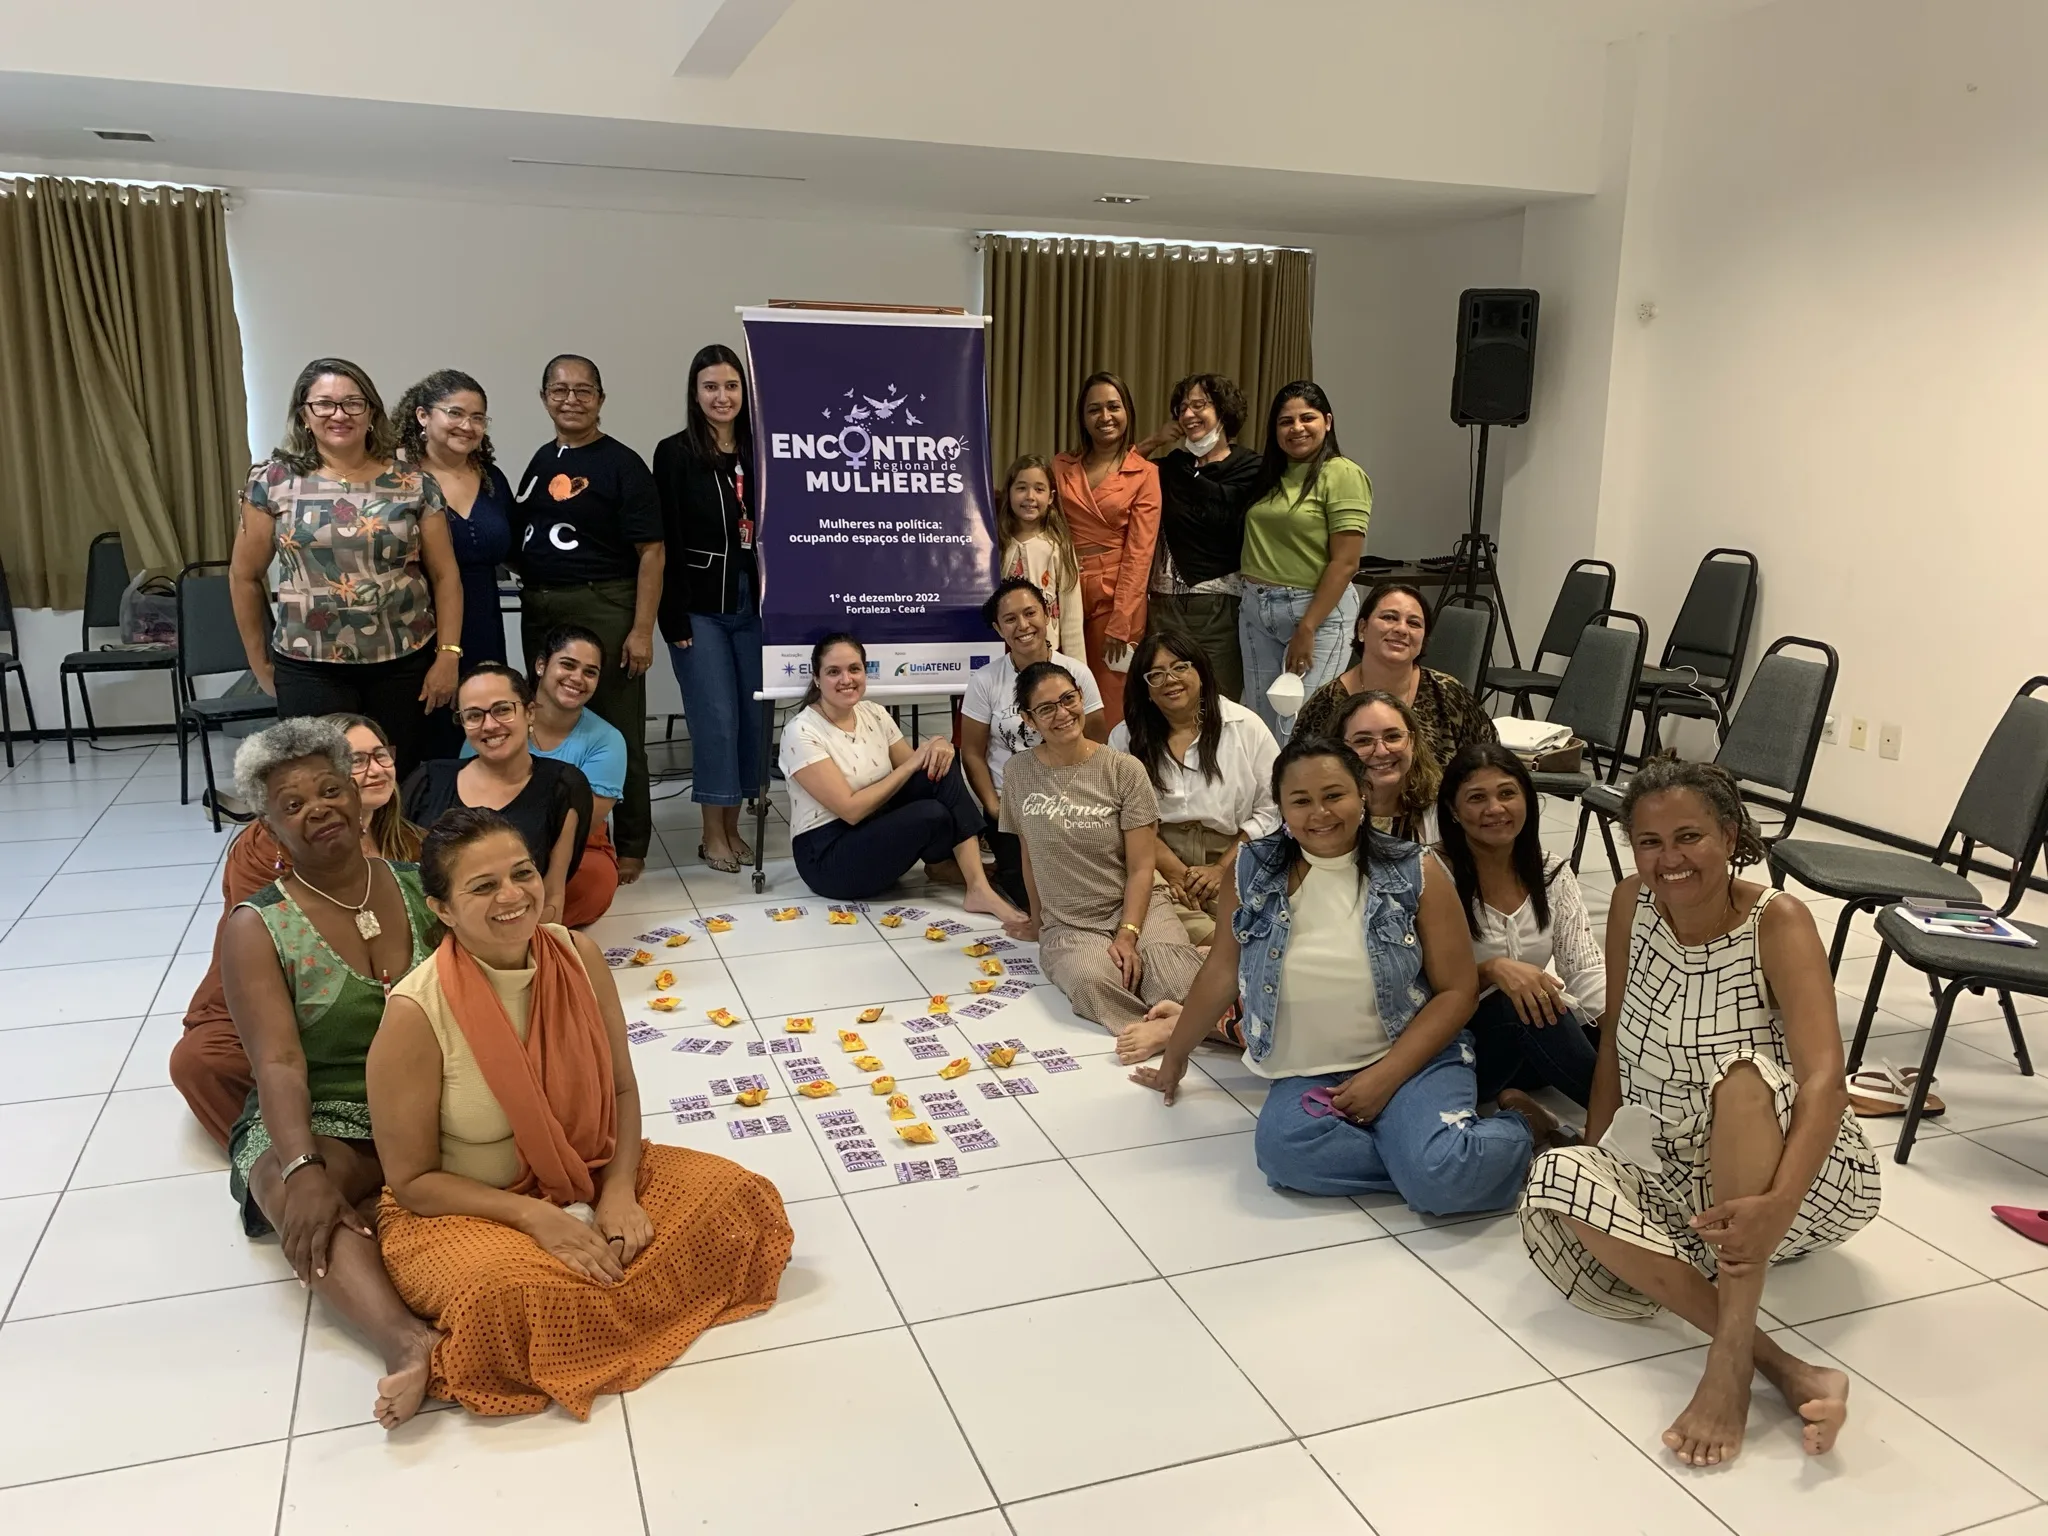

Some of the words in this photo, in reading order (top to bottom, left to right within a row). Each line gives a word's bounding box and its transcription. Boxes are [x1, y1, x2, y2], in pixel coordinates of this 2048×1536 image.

[771, 427, 963, 466] ENCONTRO
[874, 460, 935, 473] Regional
[941, 460, 957, 471] de
[806, 470, 965, 494] MULHERES
[818, 518, 875, 530] Mulheres
[878, 520, 893, 530] na
[896, 518, 942, 532] política:
[789, 532, 849, 546] ocupando
[851, 534, 899, 546] espaços
[901, 532, 916, 543] de
[918, 532, 972, 546] liderança
[843, 593, 857, 602] de
[859, 593, 913, 602] dezembro
[915, 593, 940, 602] 2022
[846, 605, 891, 614] Fortaleza
[898, 604, 926, 614] Ceará
[910, 662, 962, 672] UniATENEU
[1022, 792, 1113, 820] California
